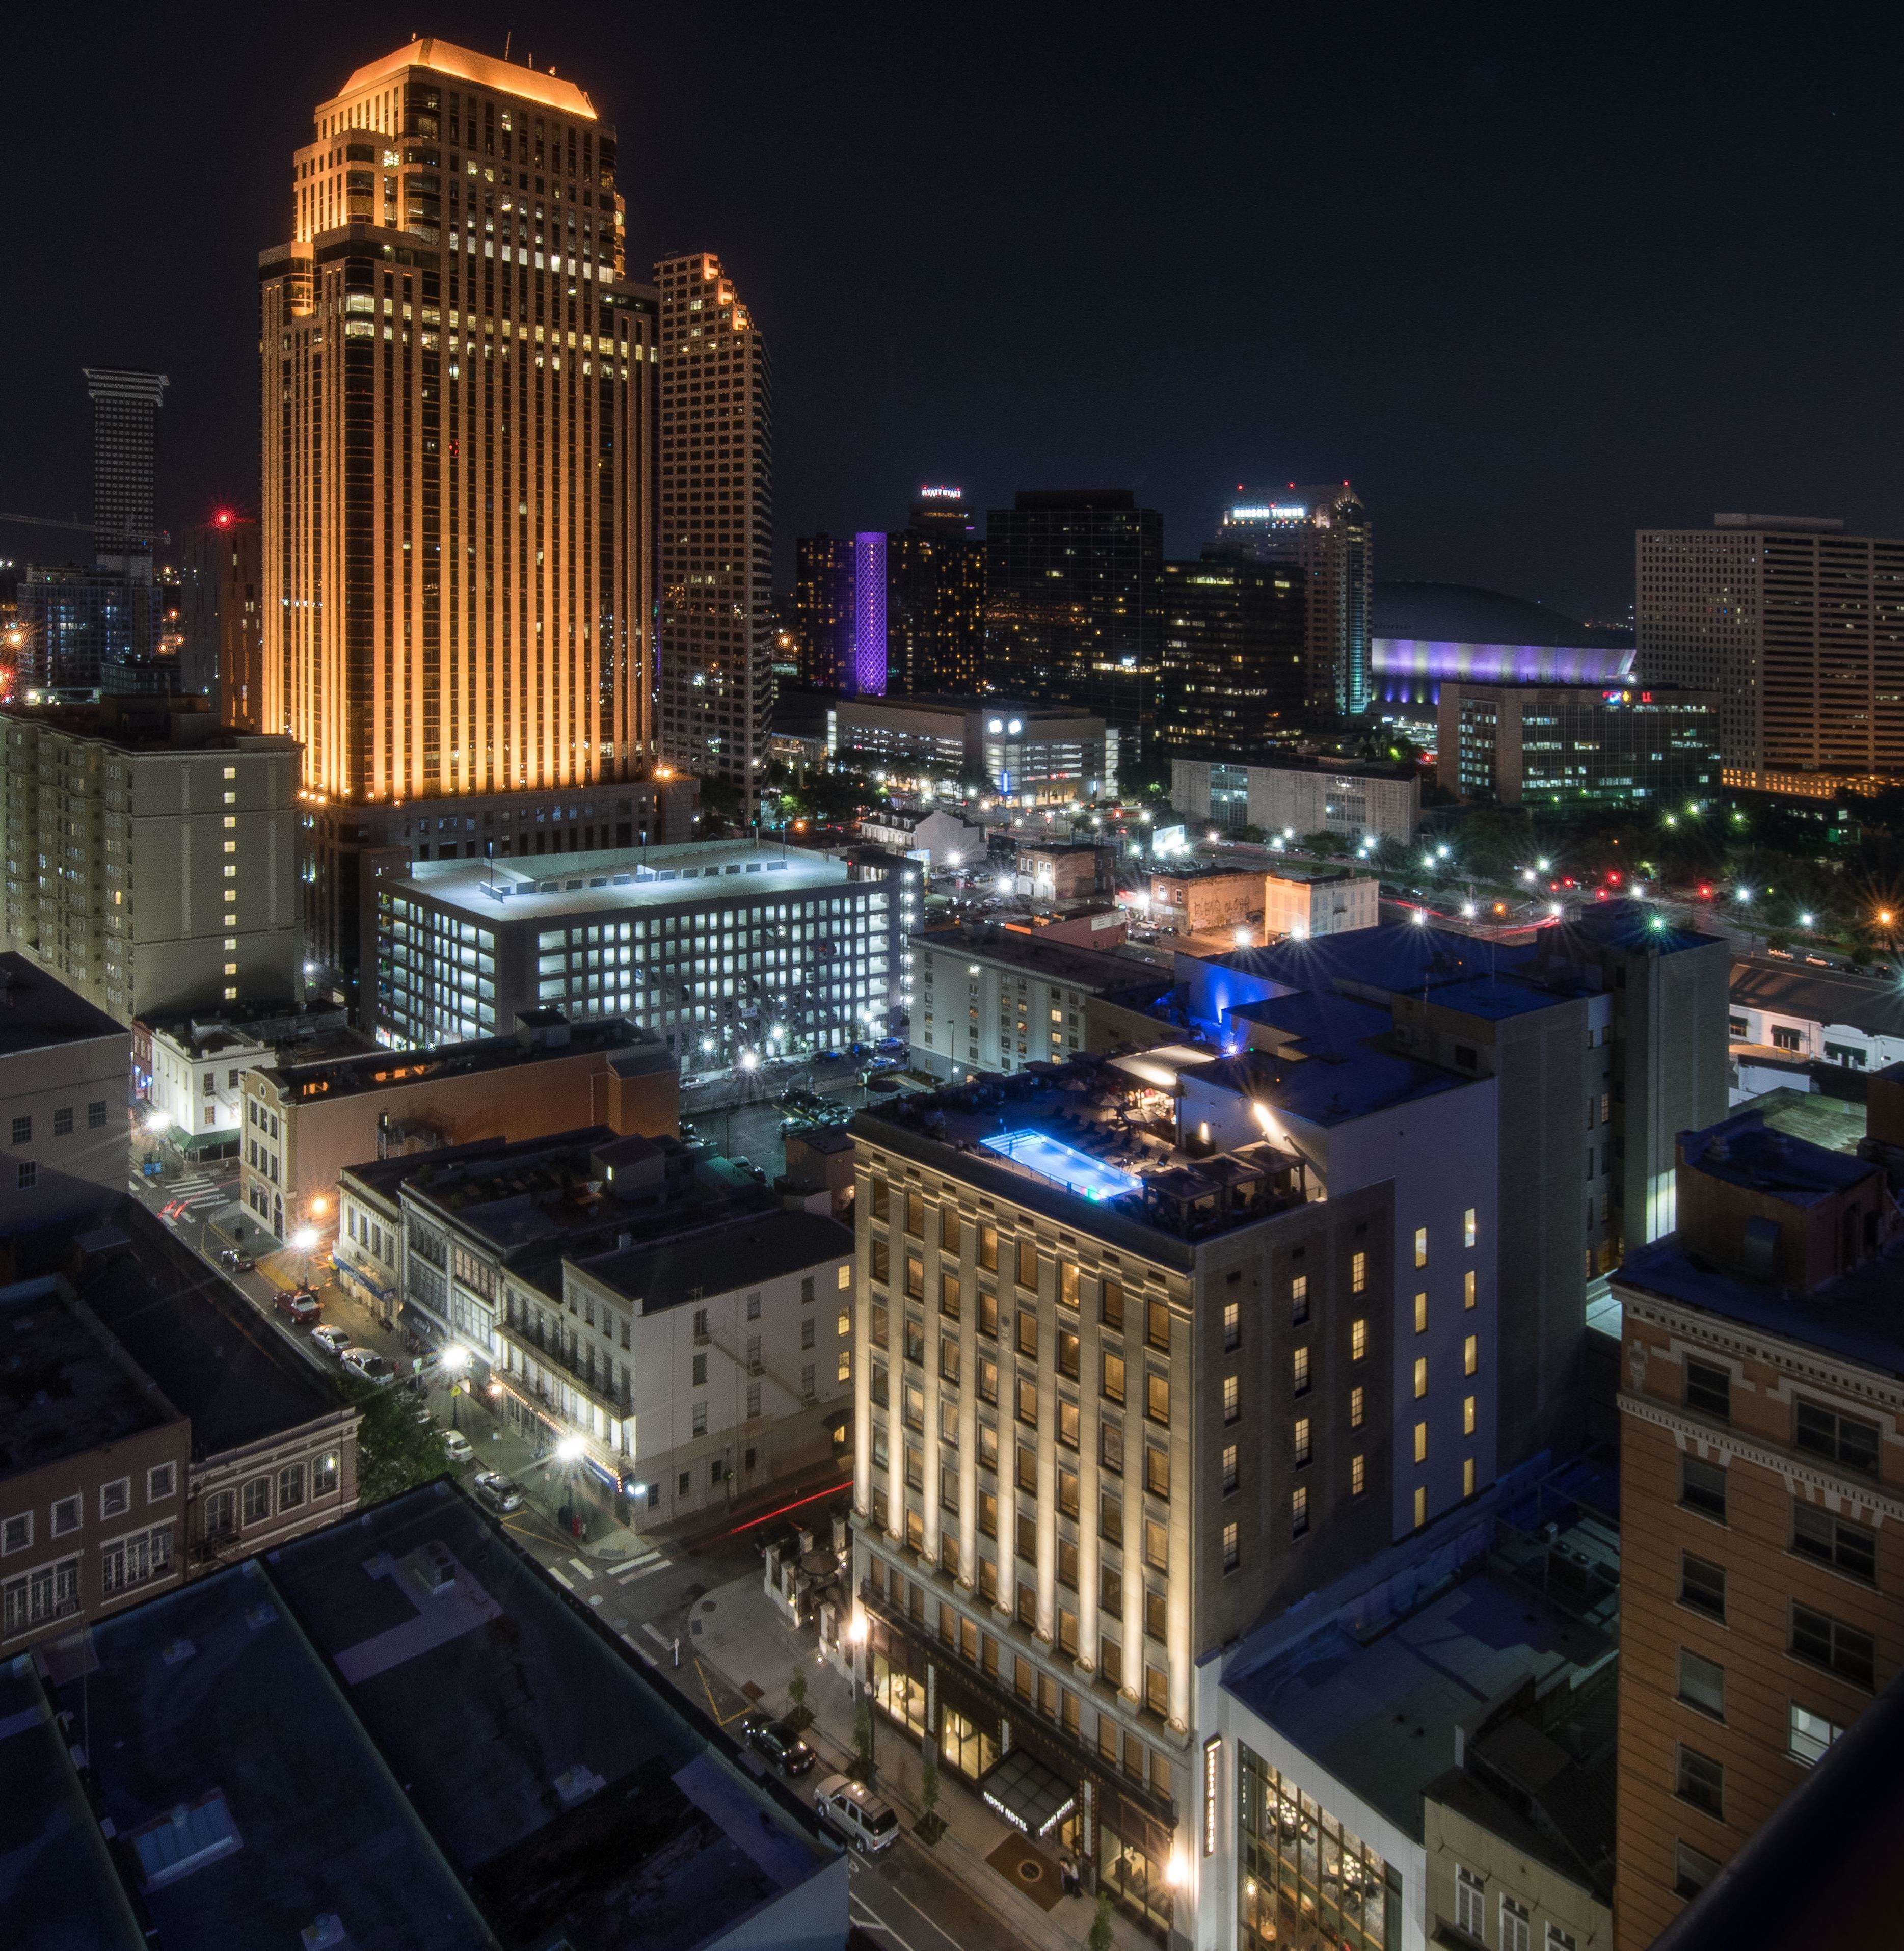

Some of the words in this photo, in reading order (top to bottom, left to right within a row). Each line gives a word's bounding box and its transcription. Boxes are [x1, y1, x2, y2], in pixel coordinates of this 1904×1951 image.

[943, 490, 961, 498] HYATT
[1234, 509, 1269, 518] BENSON
[1272, 508, 1304, 517] TOWER
